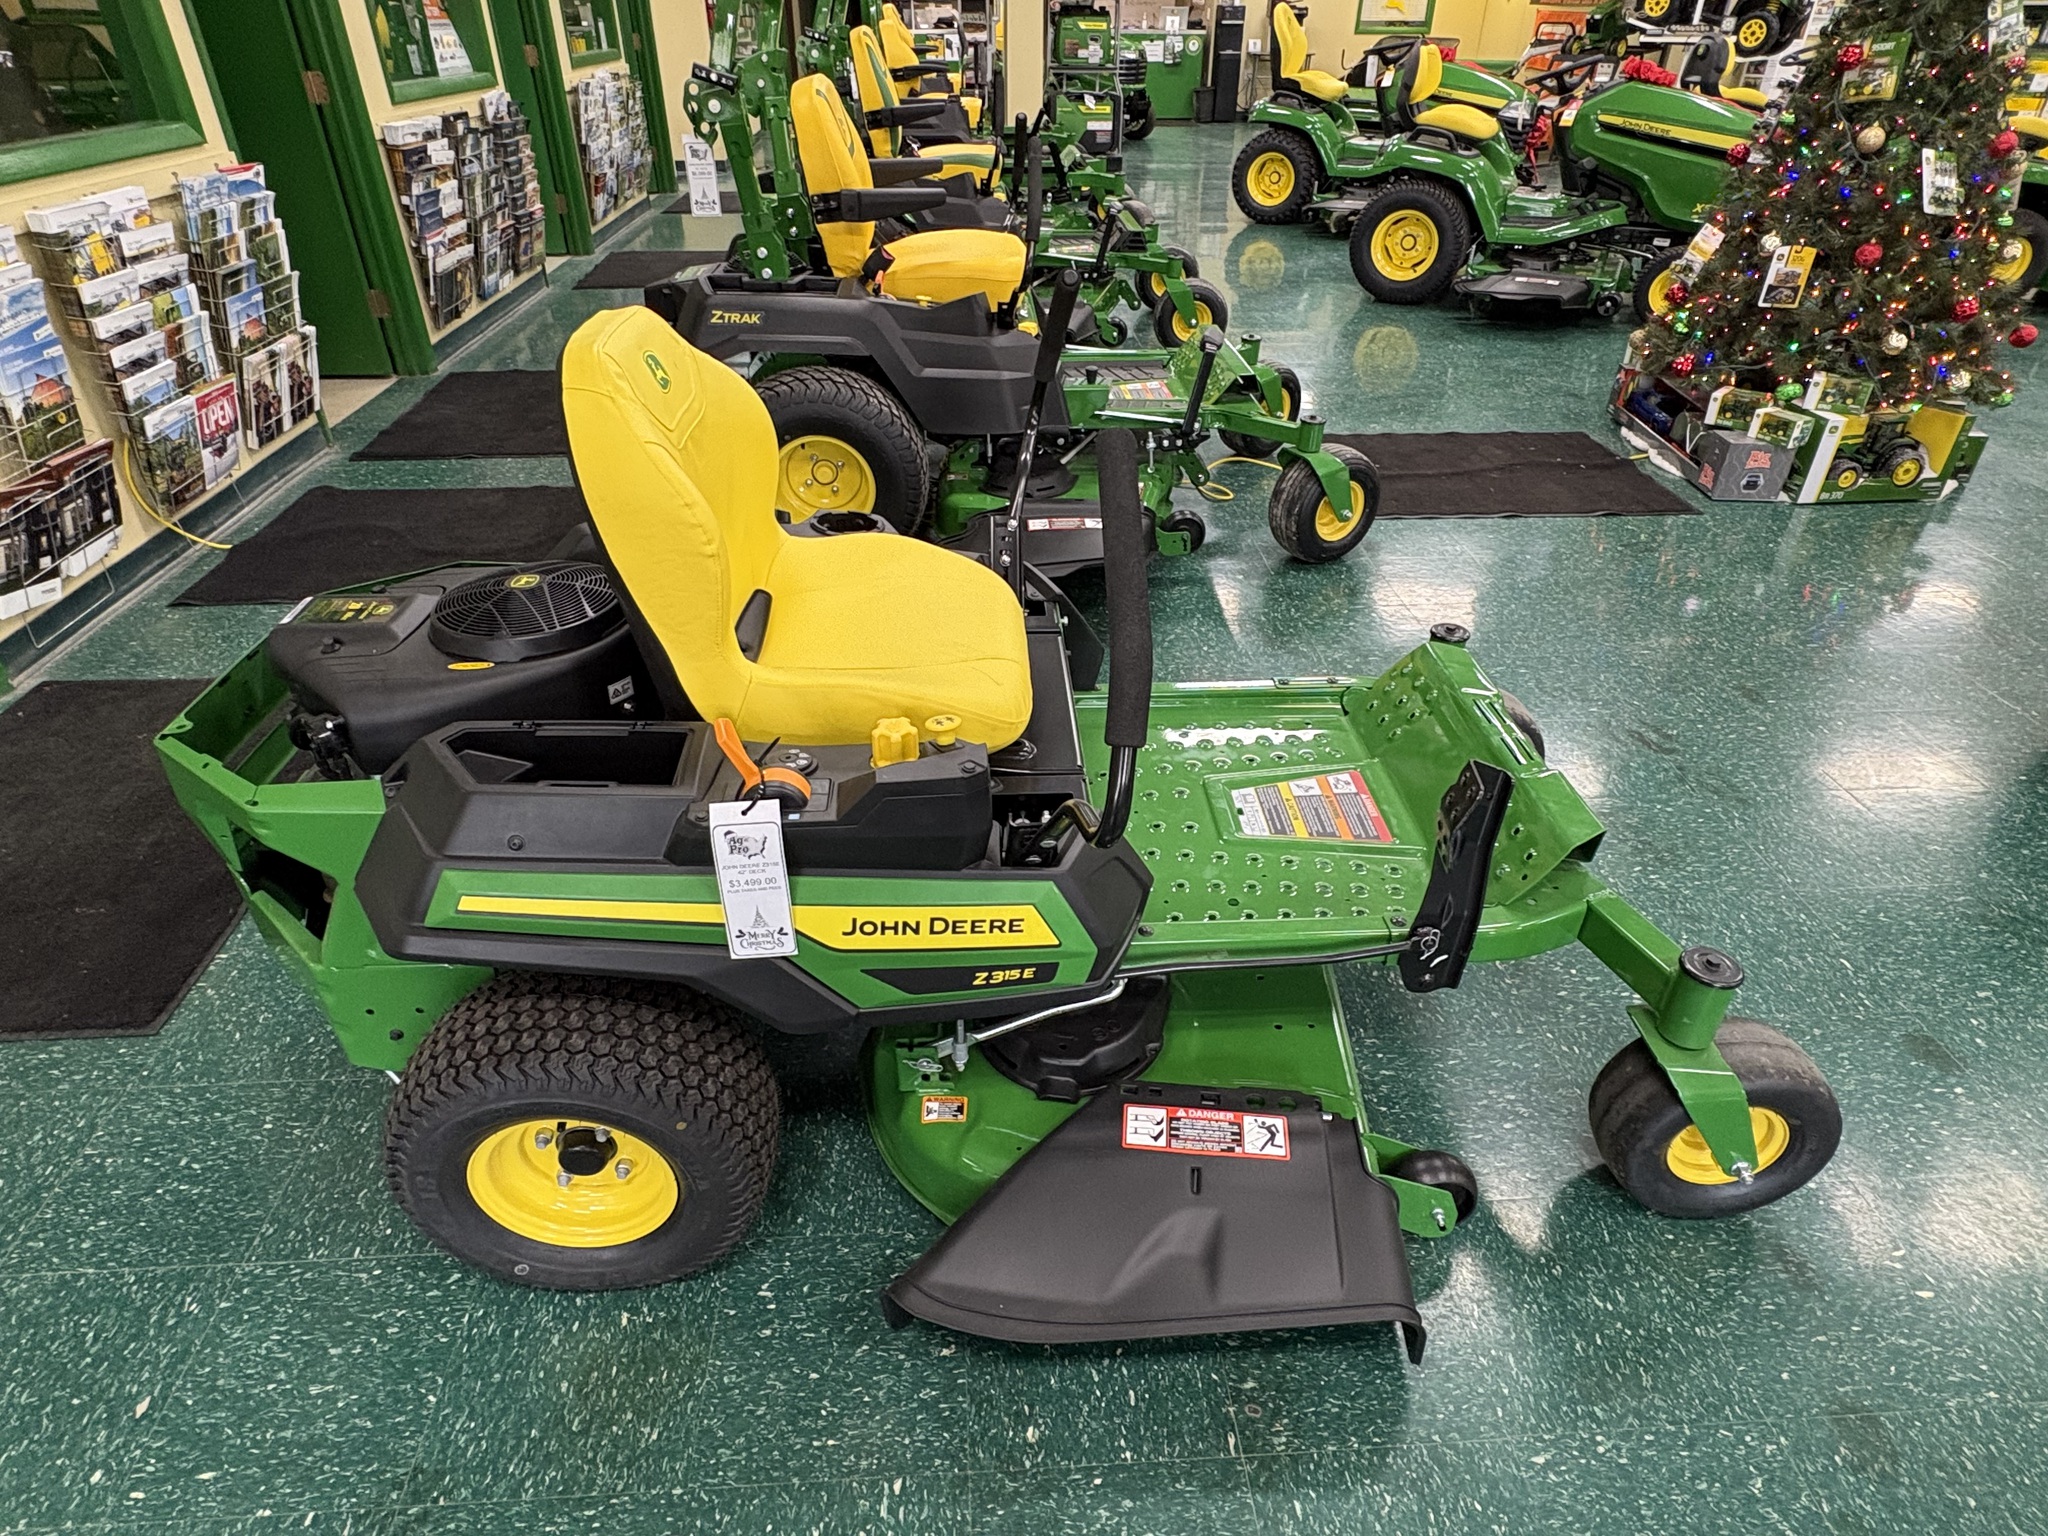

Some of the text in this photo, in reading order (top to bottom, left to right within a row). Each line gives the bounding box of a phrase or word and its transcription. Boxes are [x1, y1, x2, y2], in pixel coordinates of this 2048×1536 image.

[1620, 119, 1671, 136] JOHN DEERE
[710, 310, 761, 324] ZTRAK
[728, 837, 743, 846] Ag
[729, 845, 749, 855] Pro
[728, 877, 777, 888] $3,499.00
[842, 917, 1025, 936] JOHN DEERE
[1188, 1109, 1234, 1120] DANGER
